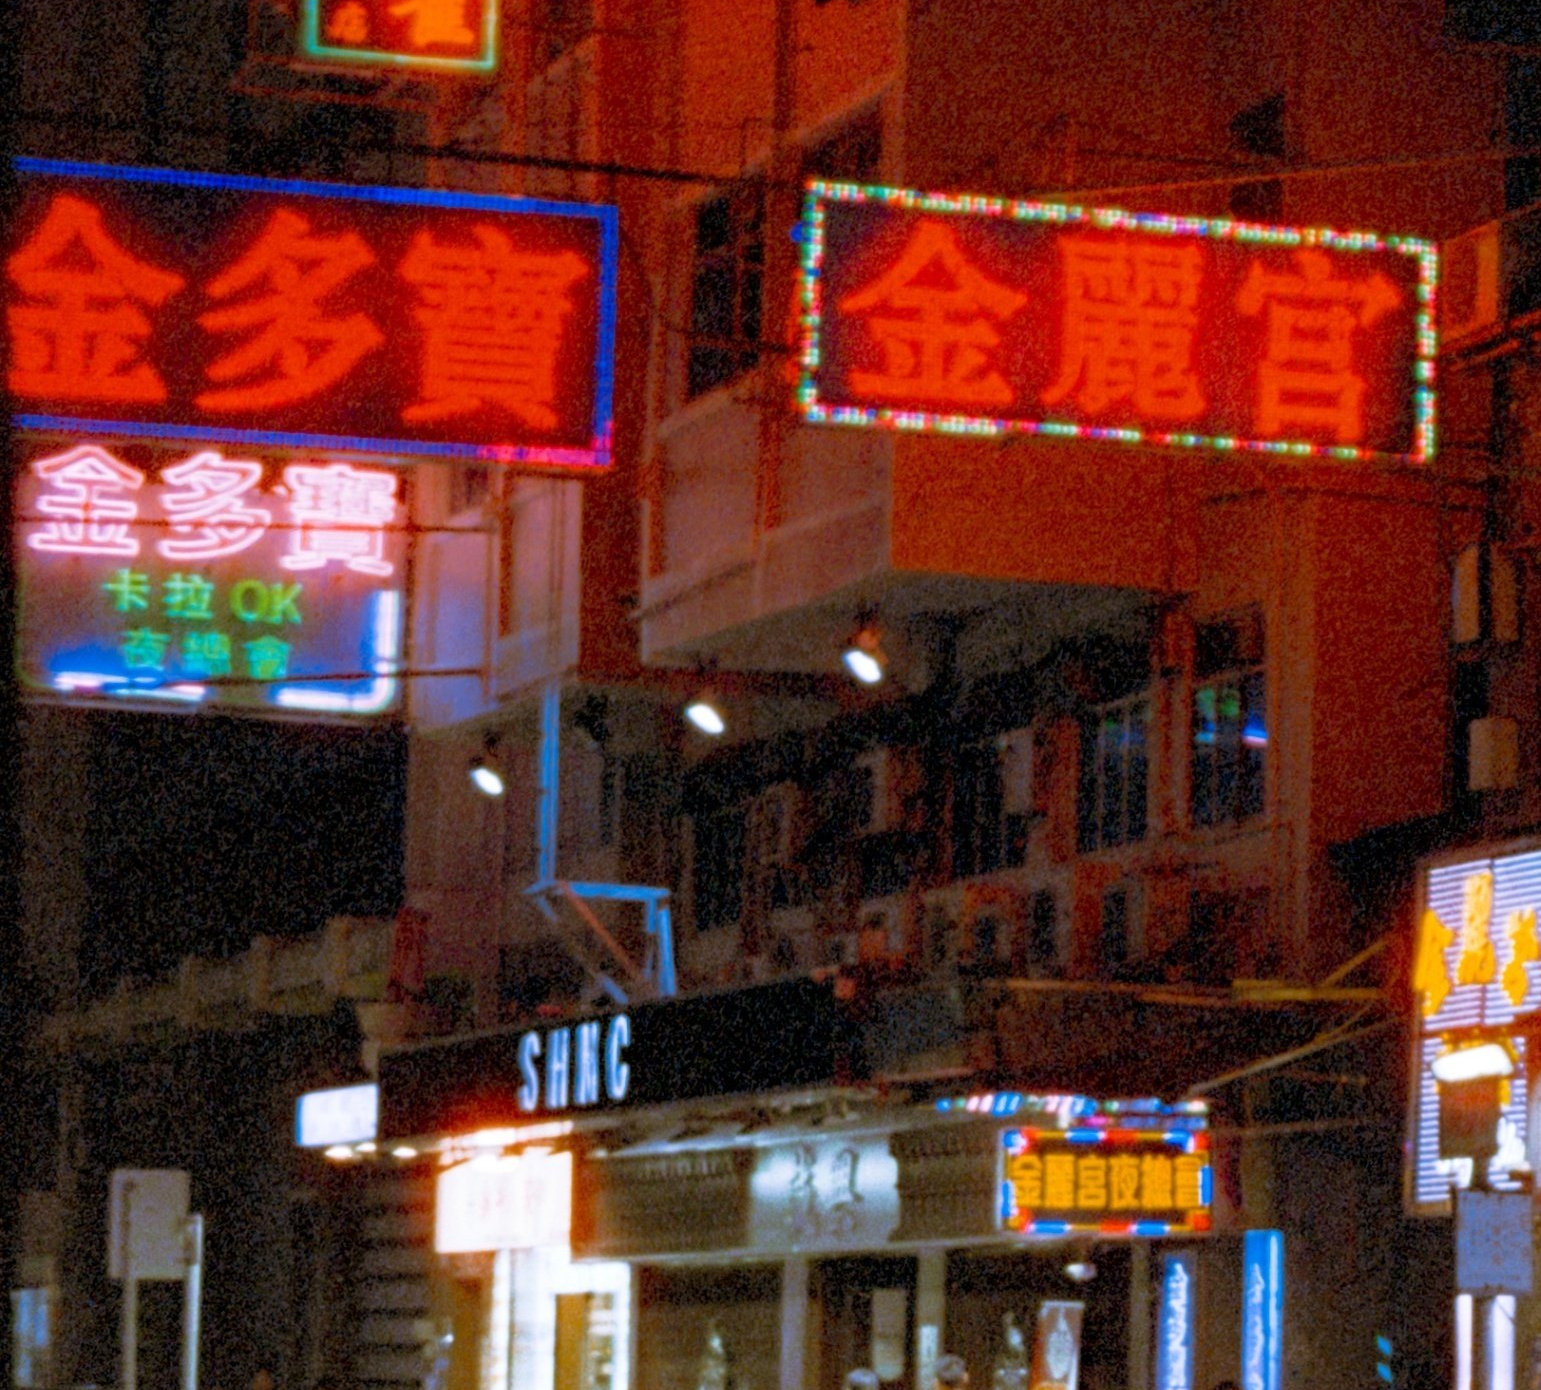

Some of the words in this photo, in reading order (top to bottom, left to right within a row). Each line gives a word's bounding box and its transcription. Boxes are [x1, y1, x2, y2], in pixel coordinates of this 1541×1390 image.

[6, 192, 592, 429] 金多寶
[840, 218, 1403, 442] 金麗宮
[27, 443, 399, 578] 金多寶
[1012, 1152, 1202, 1210] 金麗宮夜總會
